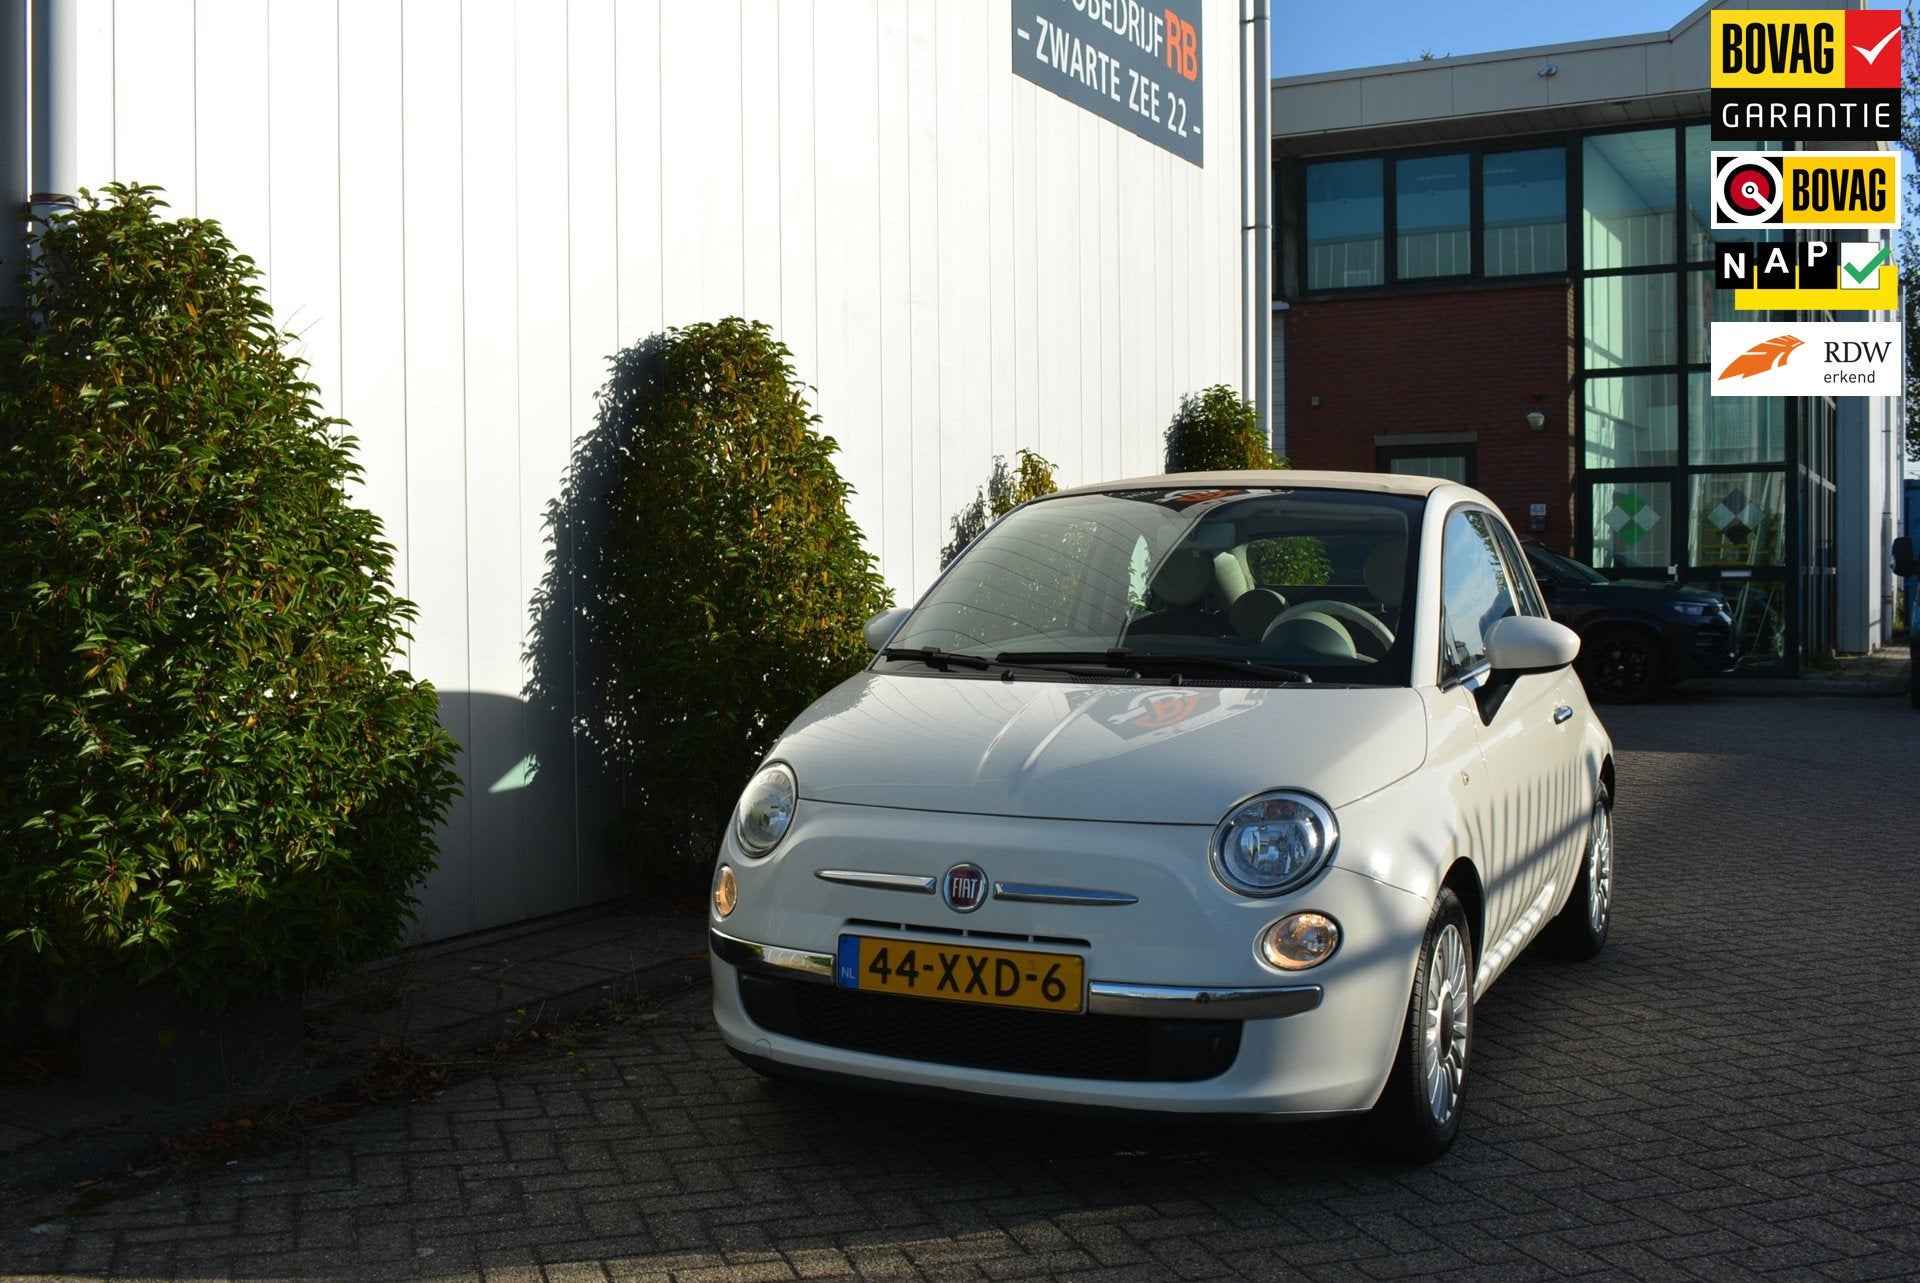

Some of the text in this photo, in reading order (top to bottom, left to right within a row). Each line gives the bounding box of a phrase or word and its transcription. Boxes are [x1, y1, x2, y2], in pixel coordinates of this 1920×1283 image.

[1036, 15, 1121, 102] ZWARTE
[1128, 68, 1160, 123] ZEE
[1167, 91, 1187, 138] 22
[1164, 8, 1198, 82] RB
[952, 877, 978, 899] FIAT
[841, 946, 1066, 1003] NL 44-XXD-6
